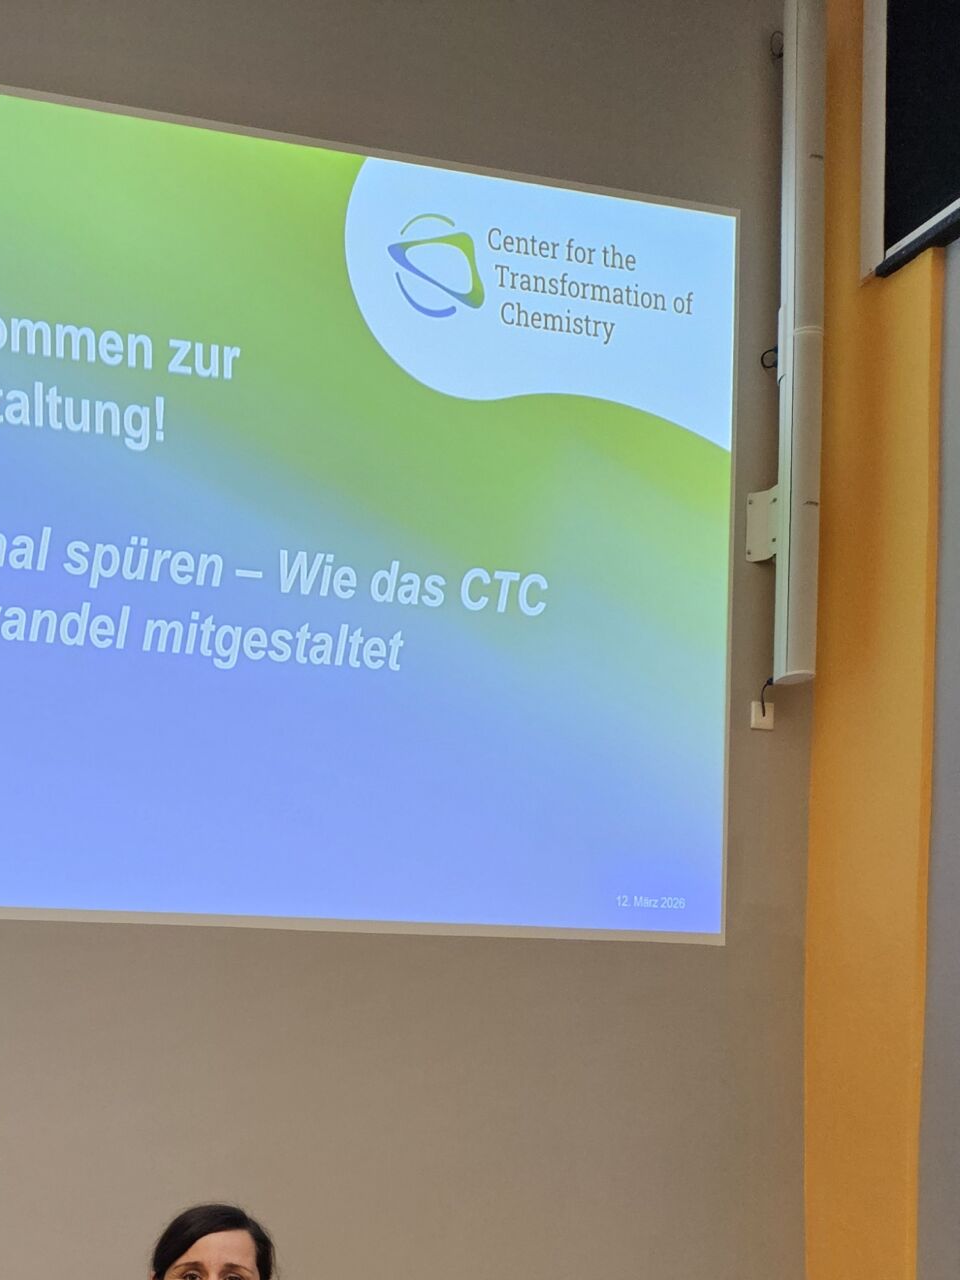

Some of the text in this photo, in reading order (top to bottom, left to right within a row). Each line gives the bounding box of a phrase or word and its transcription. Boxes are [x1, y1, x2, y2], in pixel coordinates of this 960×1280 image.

[487, 227, 636, 272] Center for the
[494, 264, 694, 315] Transformation of
[500, 301, 615, 345] Chemistry
[168, 338, 240, 380] zur
[63, 536, 223, 589] spüren
[279, 549, 357, 599] Wie
[370, 560, 446, 607] das
[460, 567, 548, 616] CTC
[142, 611, 404, 671] mitgestaltet
[616, 895, 686, 909] 12. März 2026
